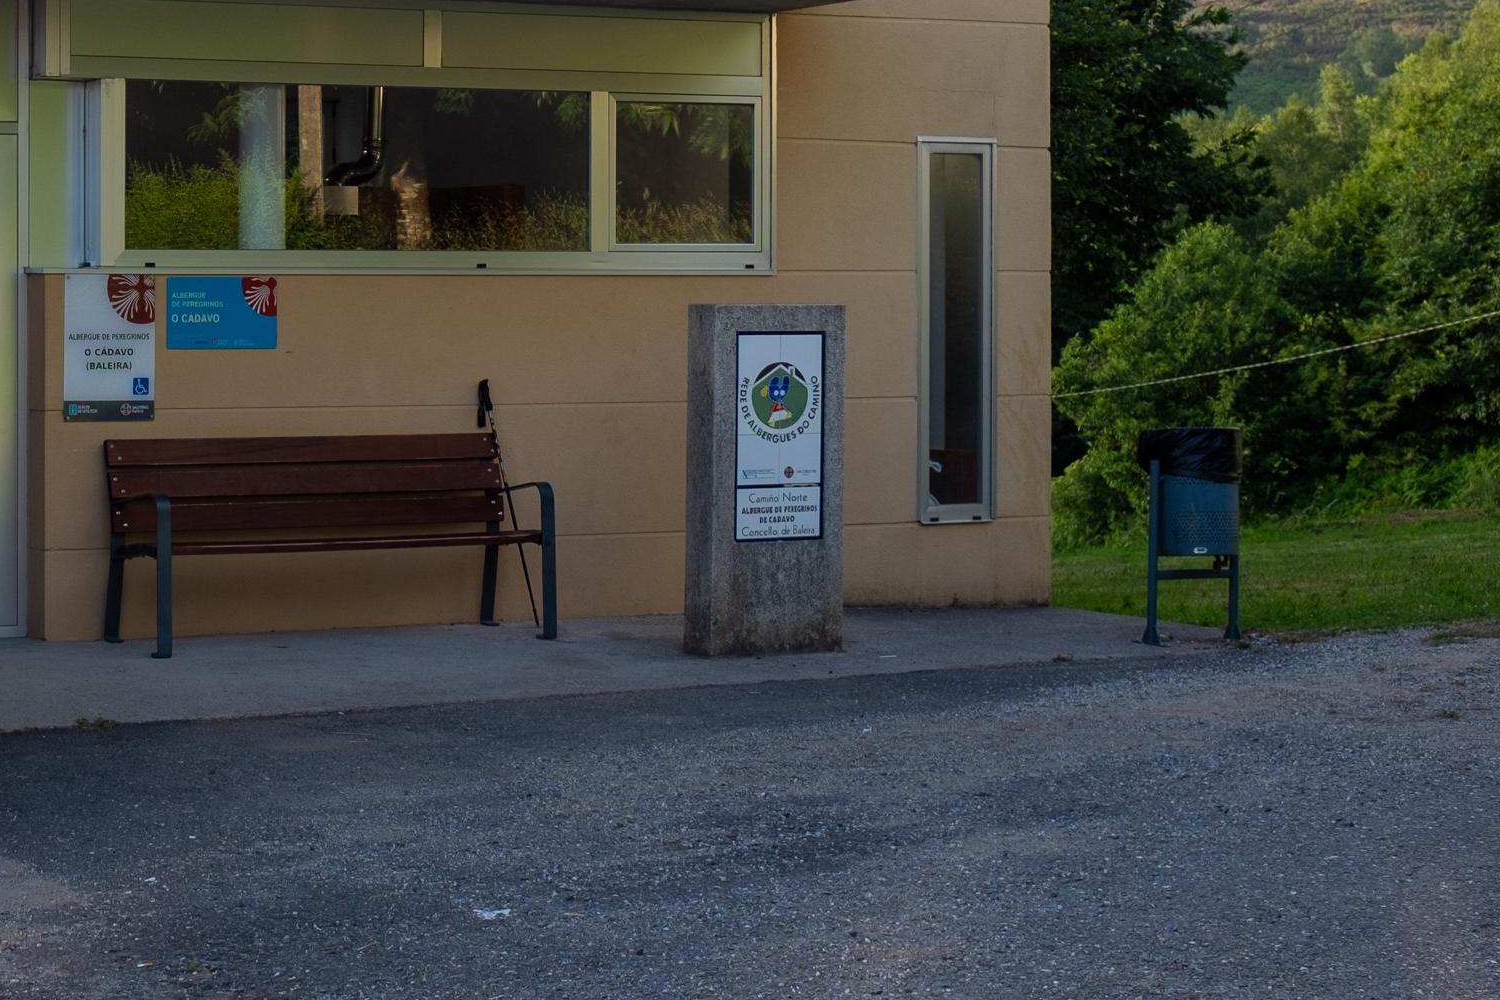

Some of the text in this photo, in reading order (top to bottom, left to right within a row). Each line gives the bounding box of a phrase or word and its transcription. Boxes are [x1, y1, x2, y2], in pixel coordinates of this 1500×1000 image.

[171, 314, 179, 323] O
[68, 332, 150, 341] ALBERGUE DE PEREGRINOS
[84, 346, 134, 356] O CÁDAVO
[86, 362, 132, 371] (BALEIRA)
[740, 376, 750, 403] REDE
[741, 405, 752, 420] DE
[747, 420, 797, 444] ALBERGUES
[797, 420, 810, 435] DO
[782, 491, 808, 502] Norte
[741, 504, 818, 515] ALBERGUE DE PEREGRINOS
[759, 516, 767, 524] DE
[741, 524, 815, 537] Concello de Baleira
